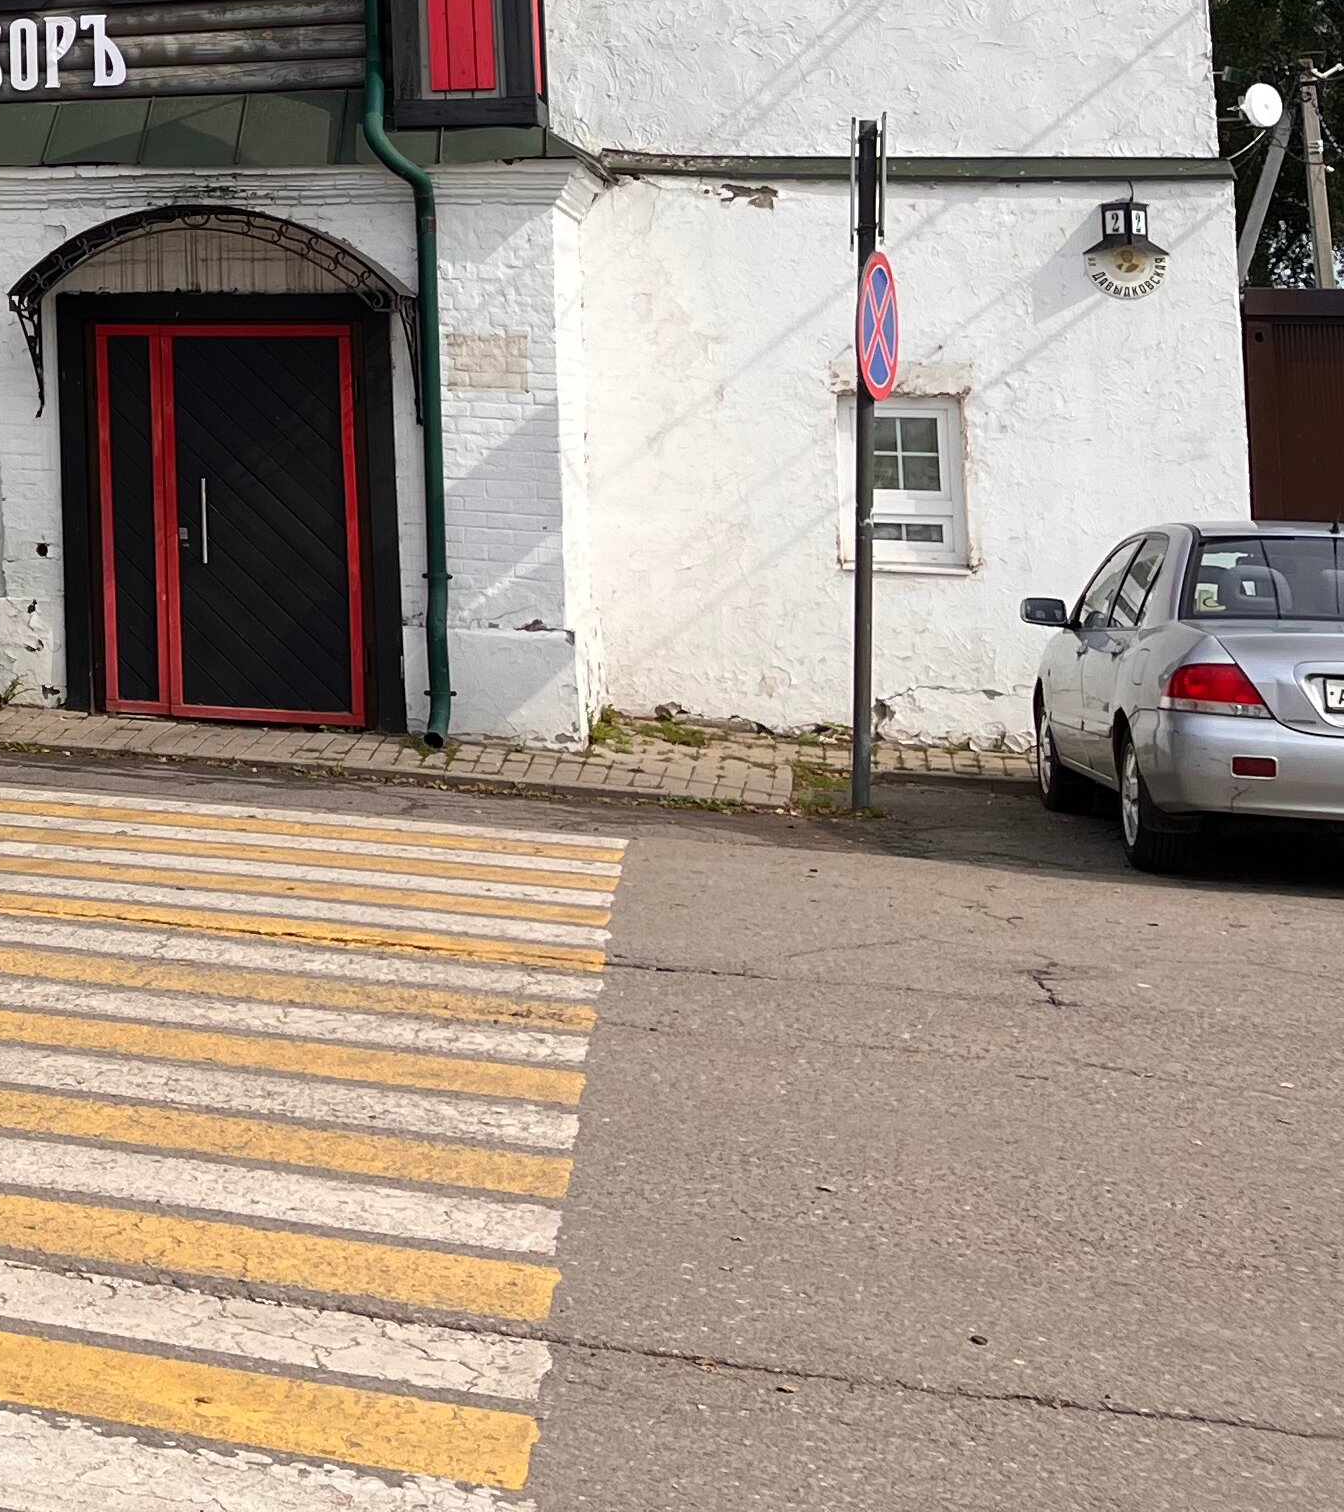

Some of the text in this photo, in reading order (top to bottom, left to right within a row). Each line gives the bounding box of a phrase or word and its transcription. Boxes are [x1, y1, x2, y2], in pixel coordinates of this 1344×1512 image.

[1111, 212, 1119, 233] 2
[1135, 212, 1142, 233] 2
[1092, 257, 1166, 297] ДАВЫДКОВСКАЯ
